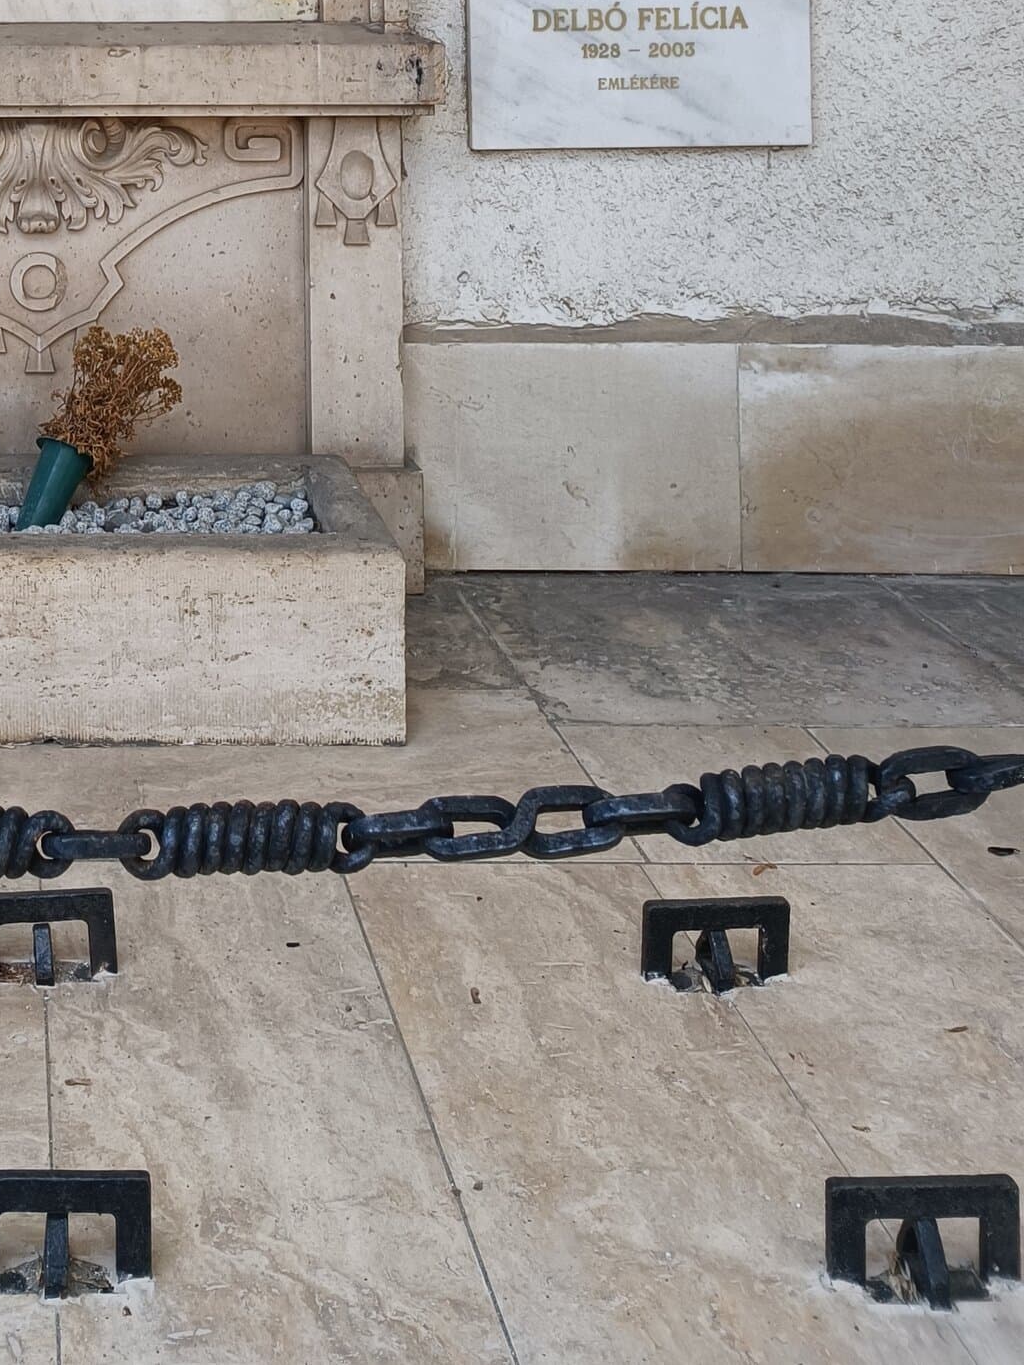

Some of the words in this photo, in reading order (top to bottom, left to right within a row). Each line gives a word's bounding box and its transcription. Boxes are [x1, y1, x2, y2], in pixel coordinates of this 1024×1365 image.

[532, 2, 627, 32] DELBÓ
[638, 3, 748, 30] FELÍCIA
[581, 44, 621, 58] 1928
[648, 43, 695, 57] 2003
[598, 74, 679, 90] EMLÉKÉRE
